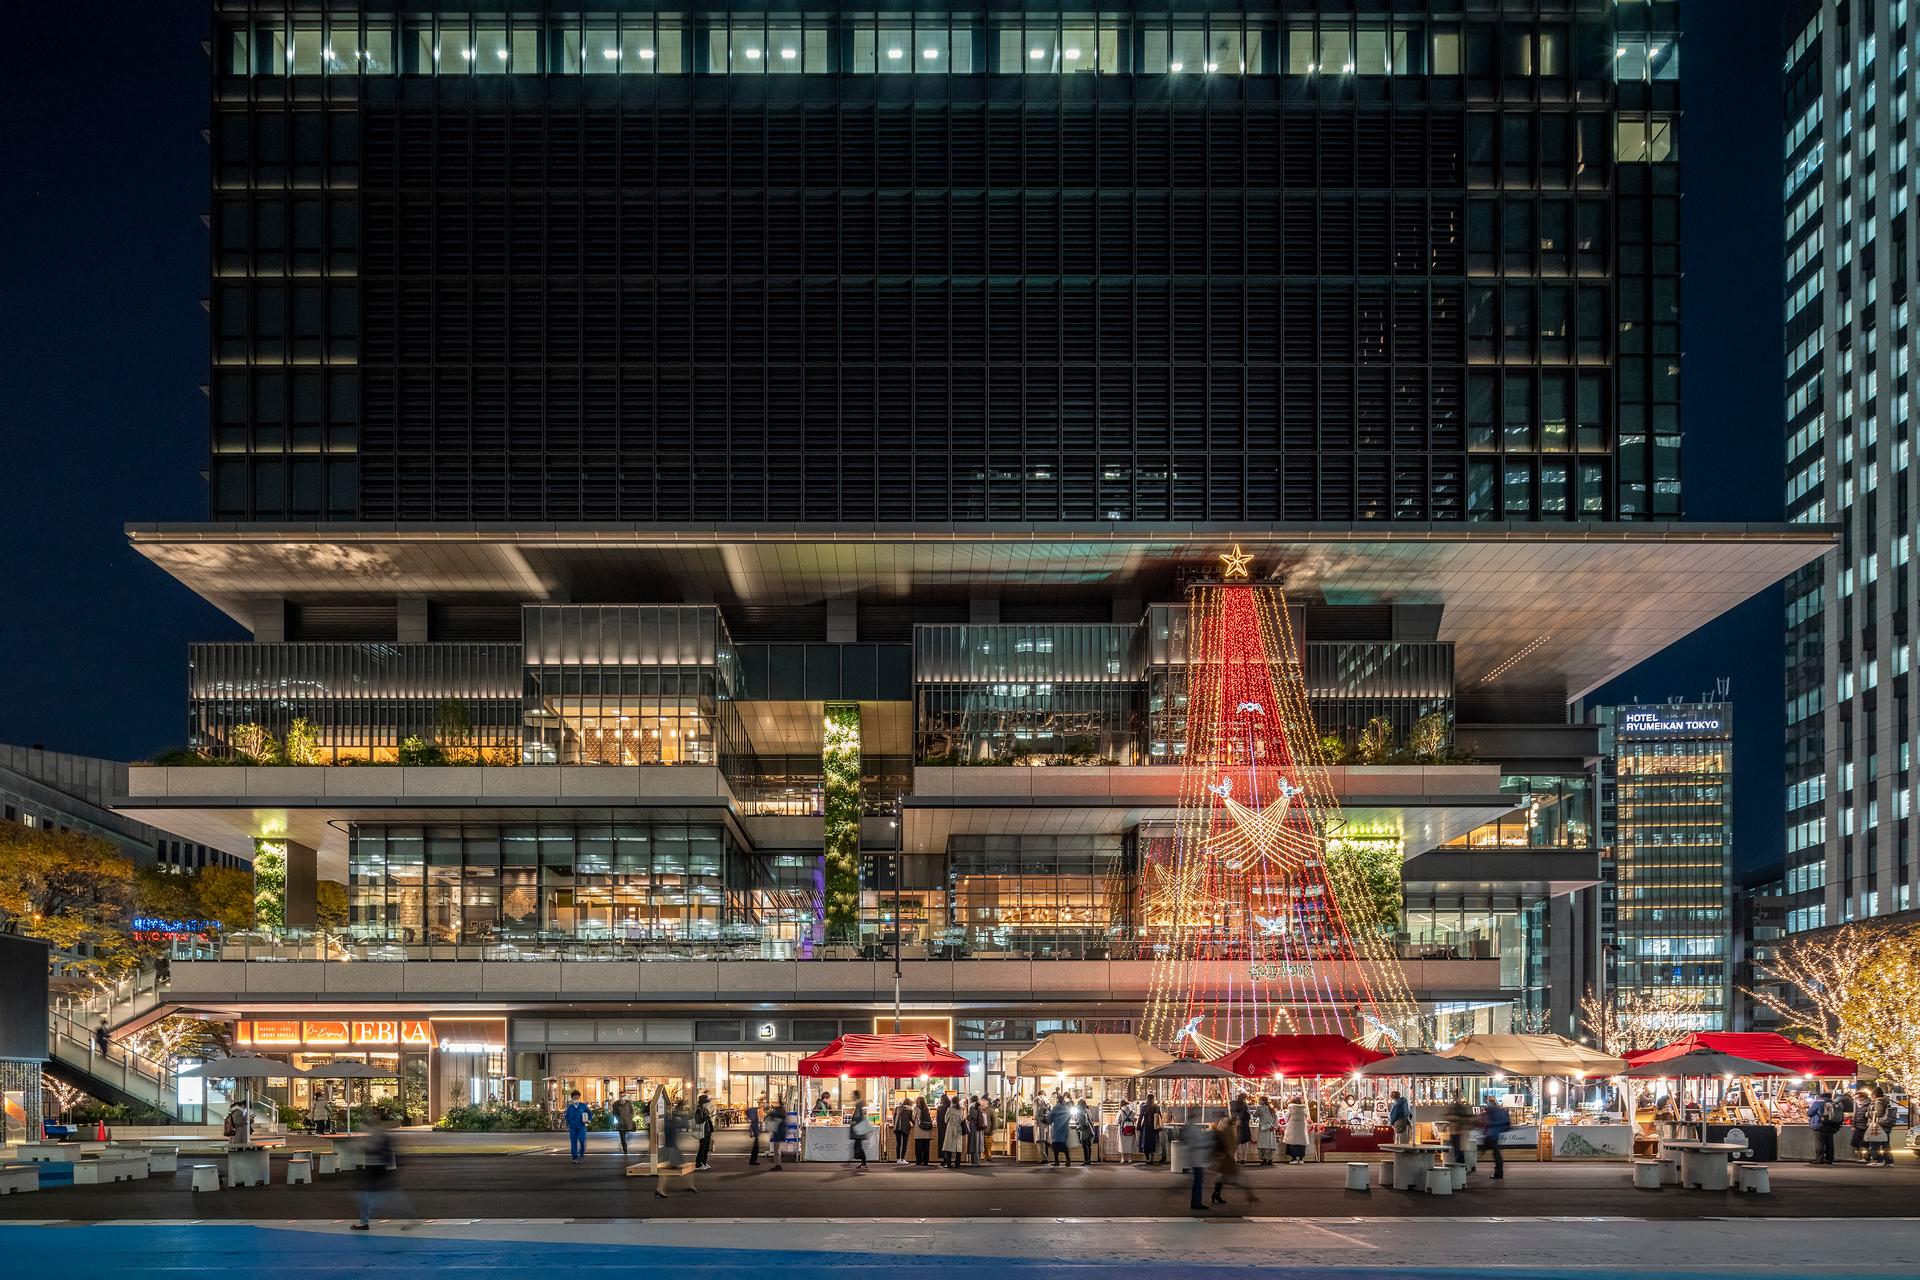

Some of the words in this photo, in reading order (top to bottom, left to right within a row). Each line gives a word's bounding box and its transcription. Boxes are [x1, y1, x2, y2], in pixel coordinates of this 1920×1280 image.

[1626, 714, 1659, 722] HOTEL
[1626, 722, 1684, 731] RYUMEIKAN
[1686, 721, 1719, 729] TOKYO
